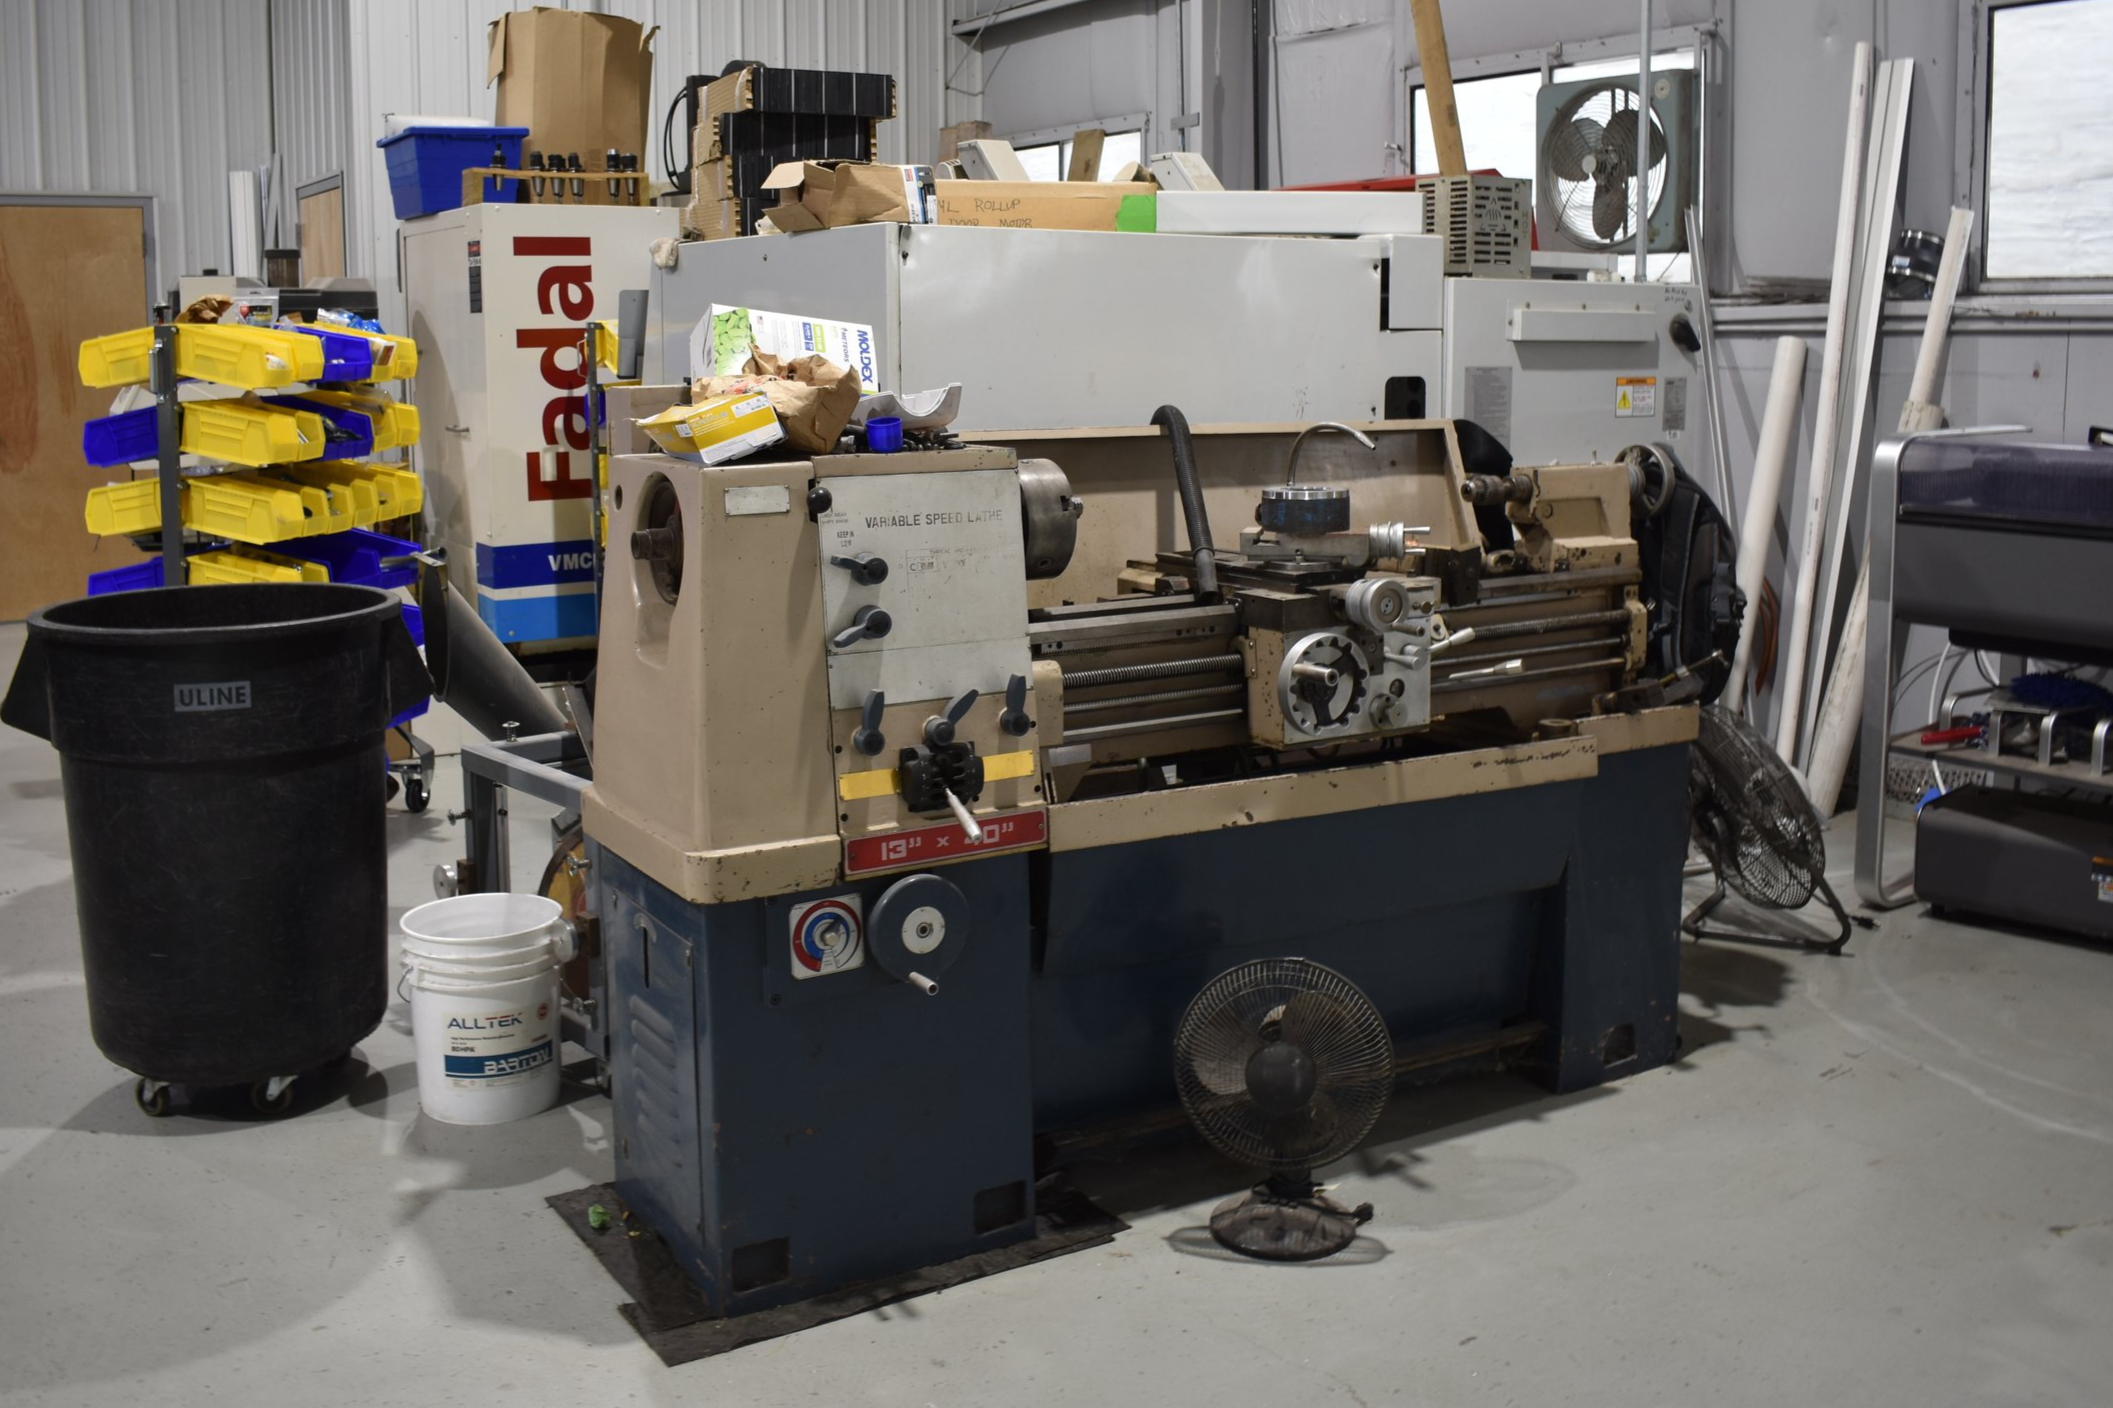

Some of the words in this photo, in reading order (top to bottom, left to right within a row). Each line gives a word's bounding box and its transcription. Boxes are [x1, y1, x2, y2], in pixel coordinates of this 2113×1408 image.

[973, 198, 1021, 213] ROLLUP
[999, 218, 1033, 229] MOTOR
[856, 329, 873, 383] MOLDEX
[512, 236, 594, 502] Fadal
[865, 514, 921, 529] VARIABLE
[925, 511, 963, 525] SPEED
[967, 509, 1003, 523] LATHE
[179, 686, 247, 707] ULINE
[447, 1013, 524, 1030] ALLTEK
[483, 1046, 551, 1075] BARTON
